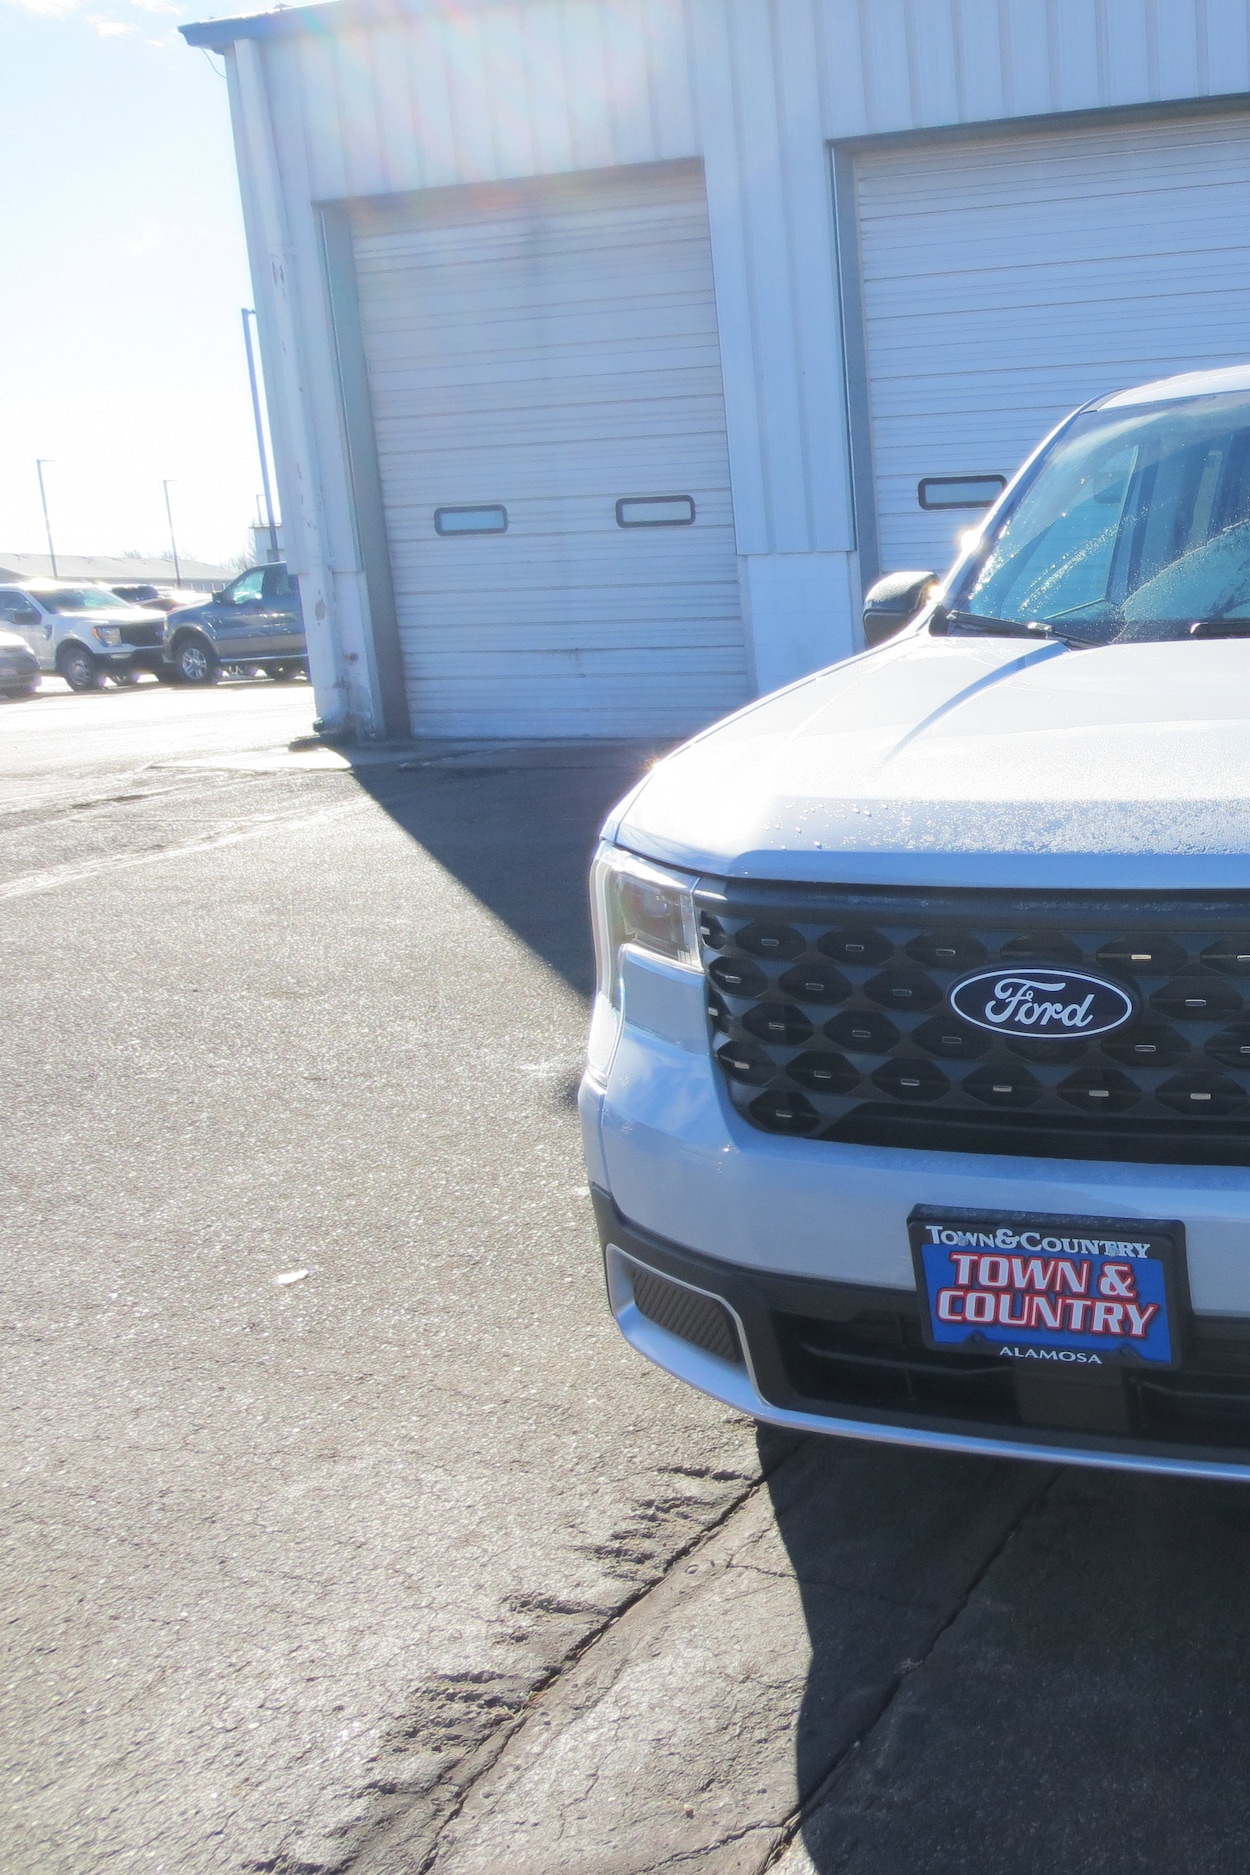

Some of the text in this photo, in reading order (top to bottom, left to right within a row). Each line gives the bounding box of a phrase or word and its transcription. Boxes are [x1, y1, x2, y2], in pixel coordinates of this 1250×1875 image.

[985, 978, 1095, 1027] Ford
[949, 1252, 1136, 1298] TOWN &
[936, 1288, 1158, 1337] COUNTRY
[1000, 1346, 1102, 1364] ALAMOSA
